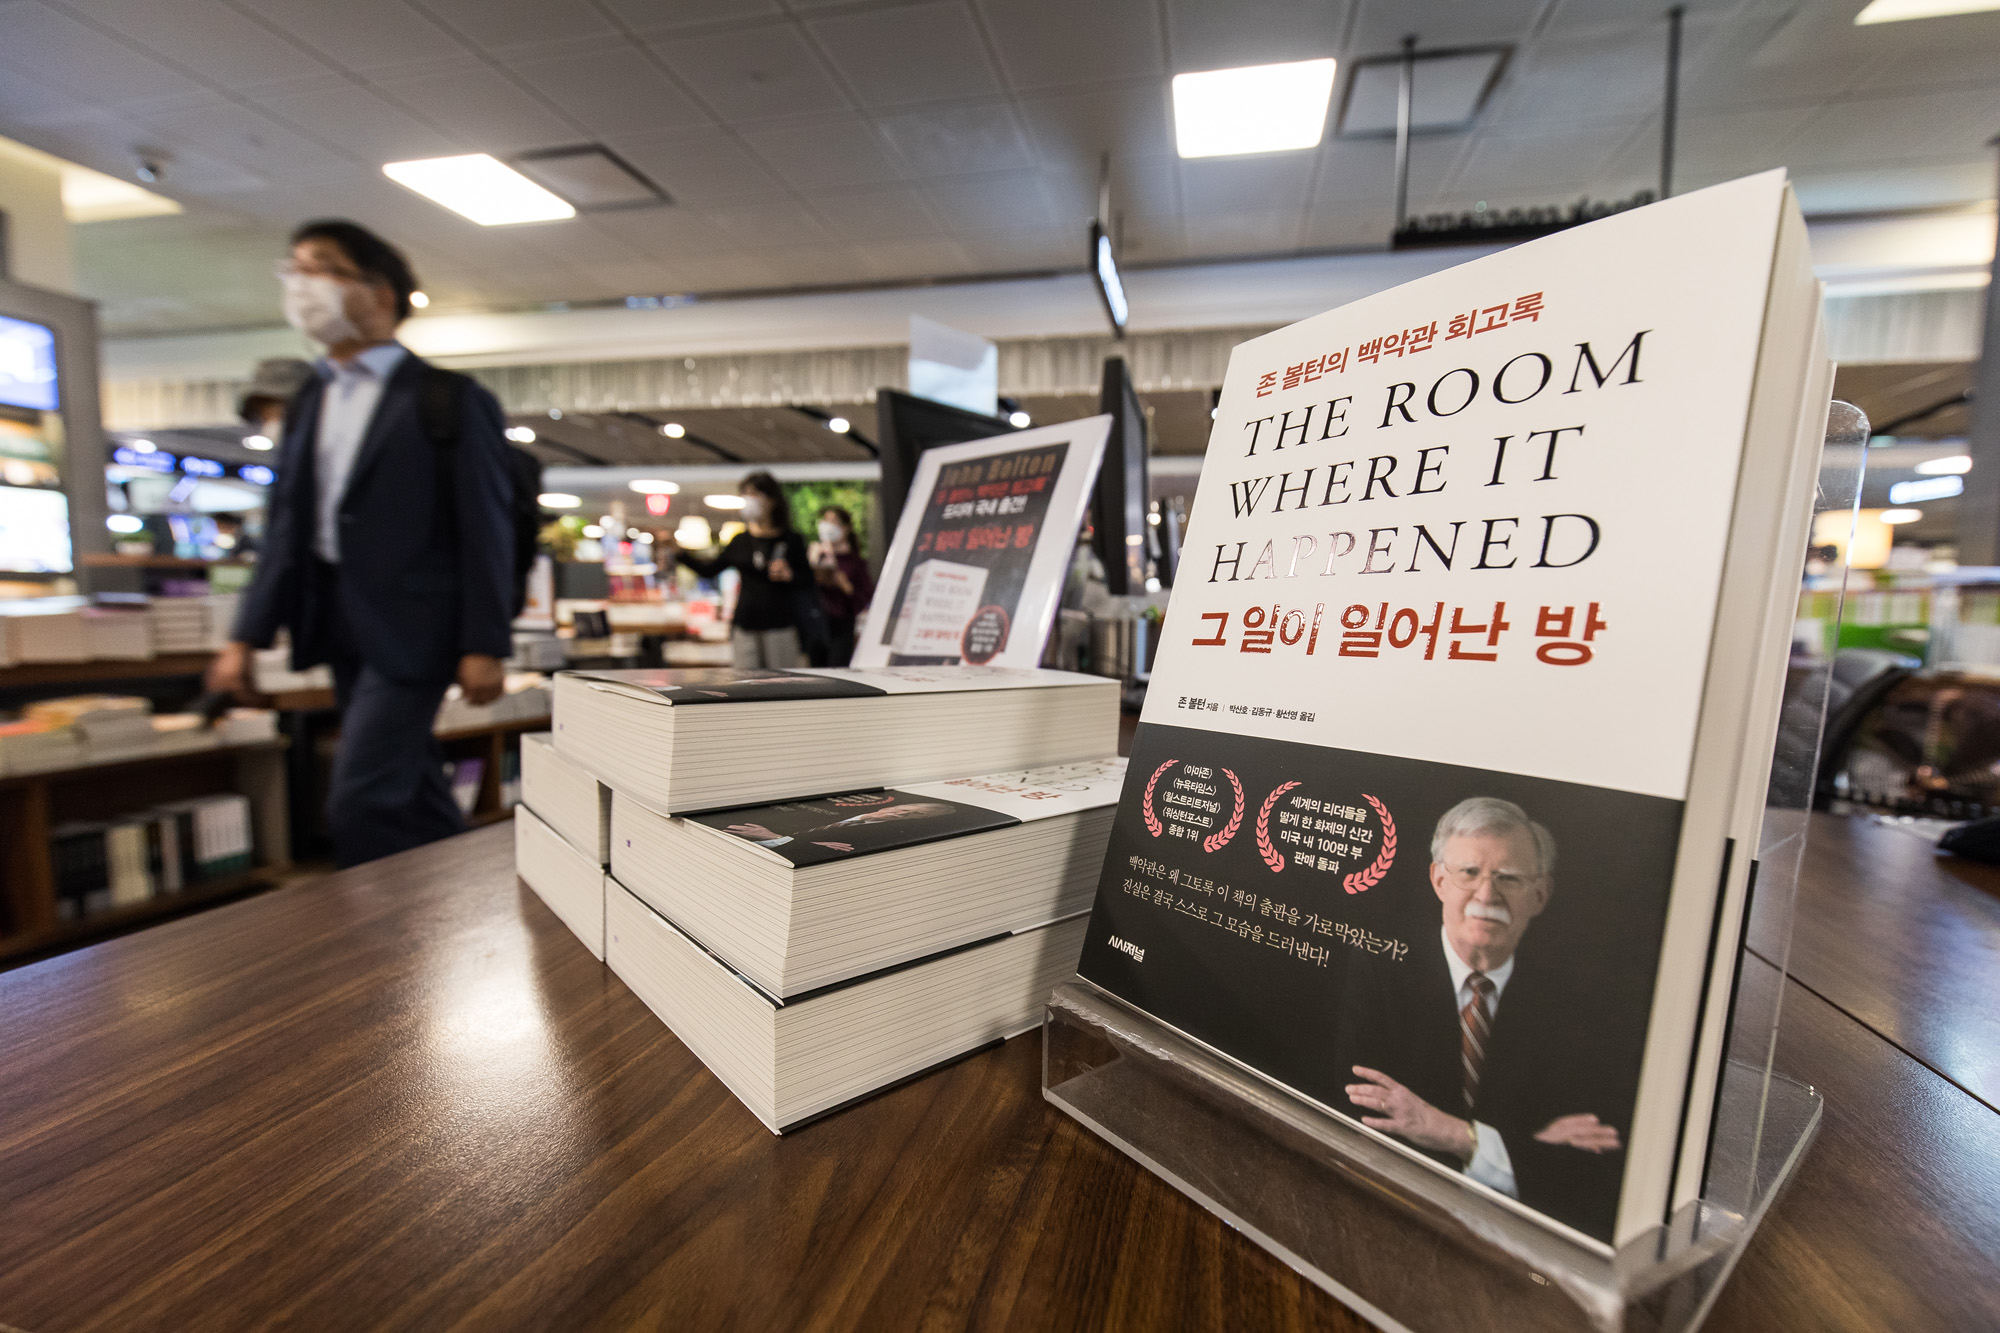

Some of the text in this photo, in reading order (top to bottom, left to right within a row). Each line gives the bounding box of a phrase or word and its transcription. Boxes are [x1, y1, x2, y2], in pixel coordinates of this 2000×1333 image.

[1256, 291, 1545, 398] 존 볼턴의 백악관 회고록
[1243, 328, 1654, 458] THE ROOM
[1229, 424, 1587, 520] WHERE IT
[1207, 513, 1602, 584] HAPPENED
[1192, 602, 1608, 667] 그 일이 일어난 방
[1178, 696, 1187, 709] 존
[1188, 697, 1206, 711] 볼턴
[1206, 702, 1219, 712] 지음
[1299, 711, 1316, 722] 옮김
[1168, 823, 1199, 842] 종합 1위
[1279, 811, 1373, 844] 떨게 한 화제의 신간
[1290, 796, 1367, 823] 세계의 리더들을
[1280, 830, 1363, 860] 미국 내 100만 부
[1294, 851, 1340, 875] 판매 돌파
[1129, 855, 1167, 880] 백악관은
[1168, 868, 1180, 885] 왜
[1180, 873, 1214, 897] 그토록
[1217, 884, 1230, 903] 이
[1232, 889, 1257, 912] 책의
[1259, 897, 1301, 926] 출판을
[1122, 878, 1330, 968] 진실은 결국 스스로 그 모습을 드러낸다!
[1108, 935, 1145, 963] 시사저널
